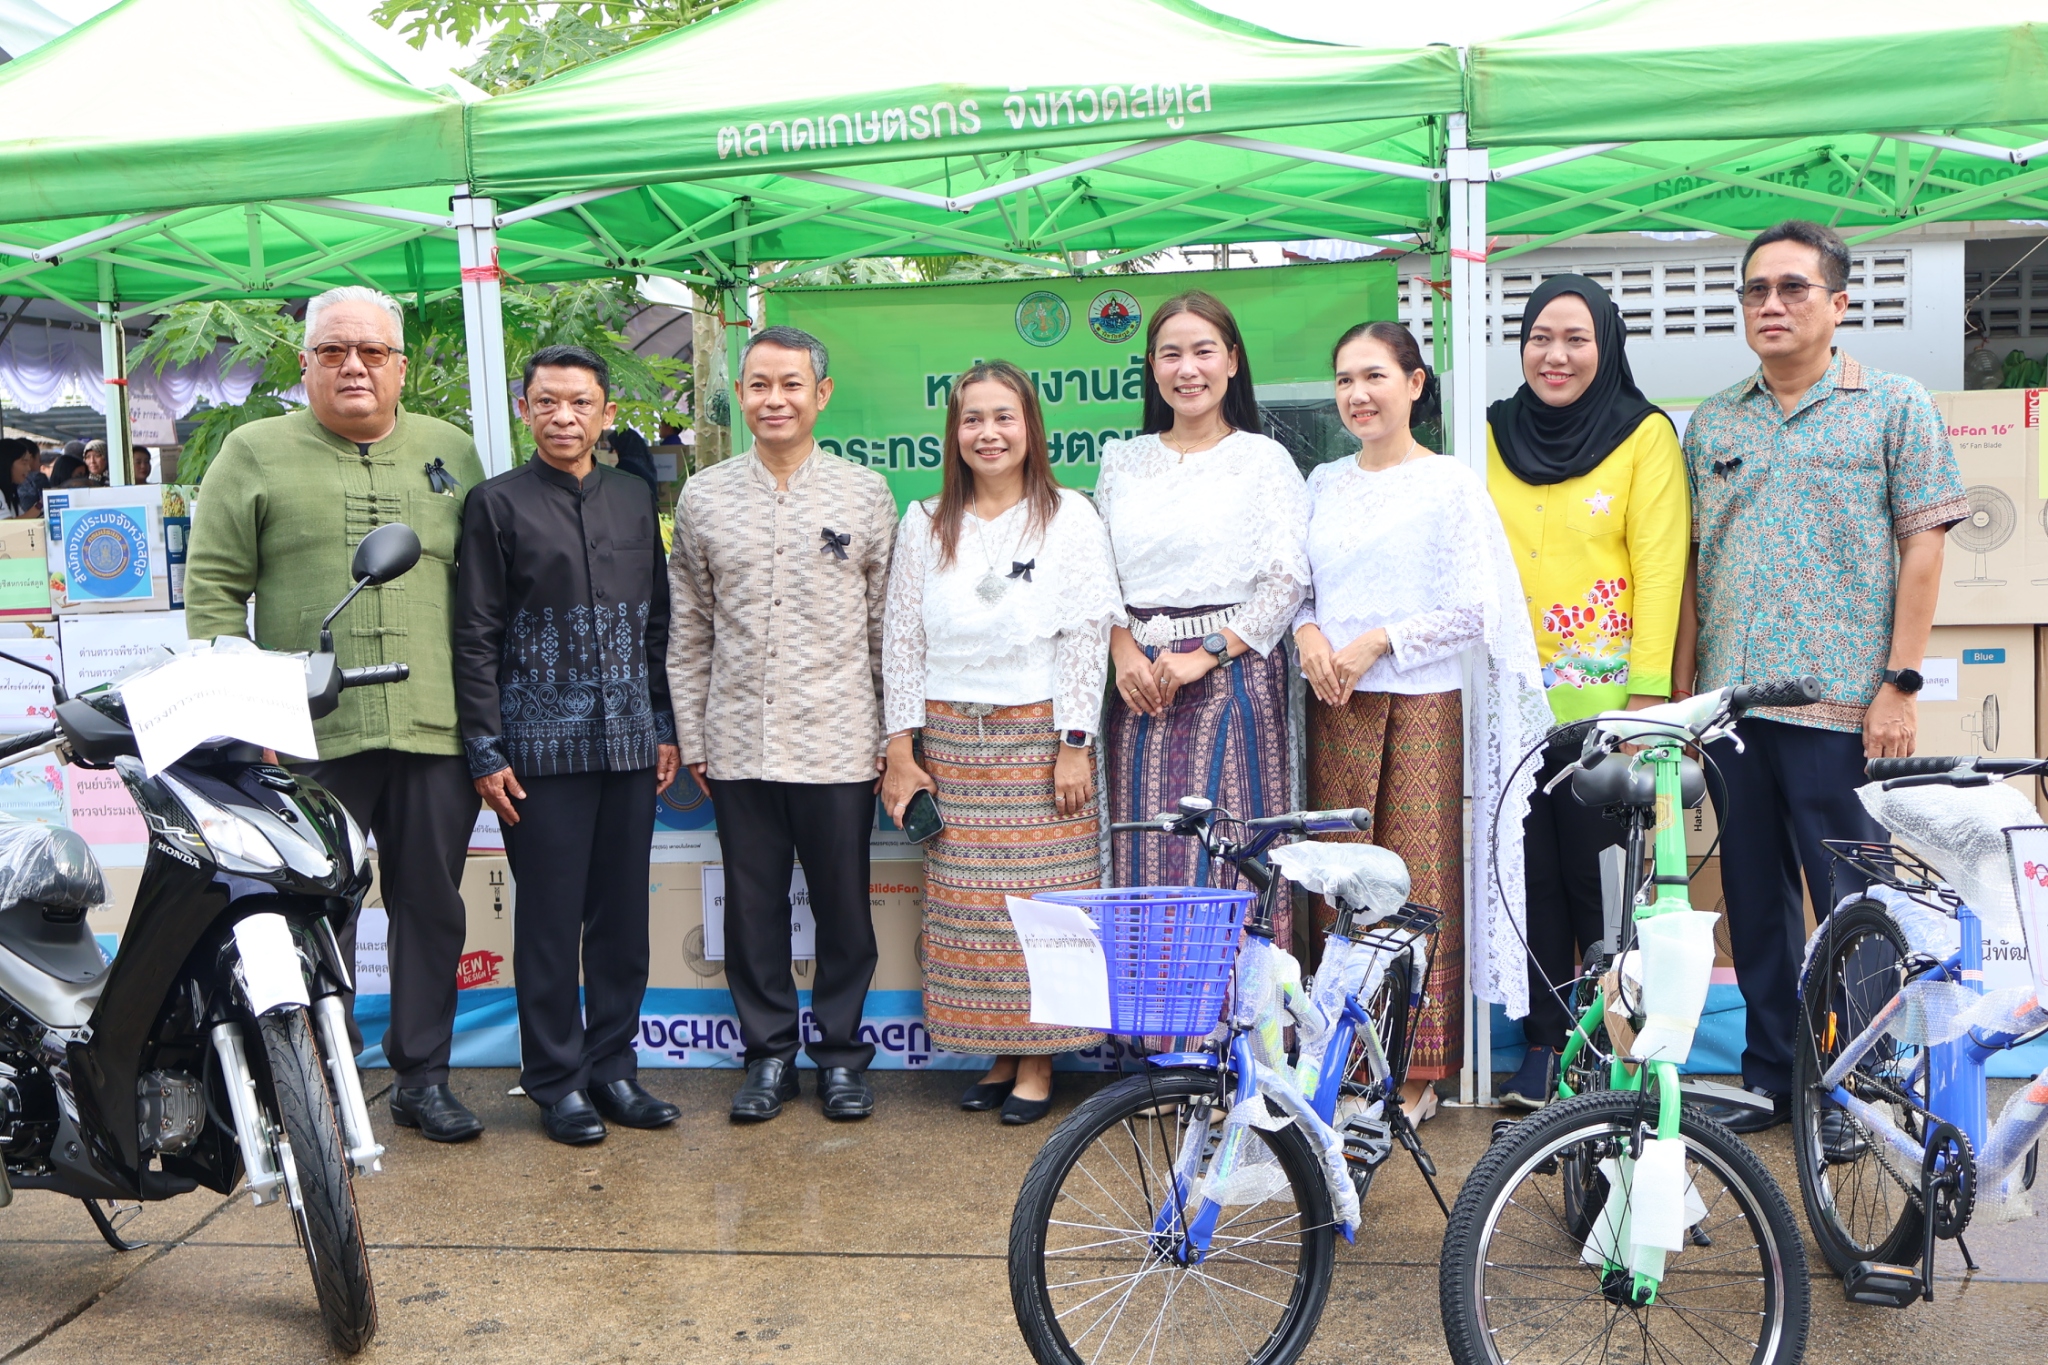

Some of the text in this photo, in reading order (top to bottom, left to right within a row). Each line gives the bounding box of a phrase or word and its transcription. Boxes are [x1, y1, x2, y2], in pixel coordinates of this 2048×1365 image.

[717, 82, 1212, 159] ตลาดเกษตรกร จังหวดสตูล
[1970, 442, 1982, 450] Fan
[1983, 441, 2002, 449] Blade
[1974, 653, 1994, 661] Blue
[157, 841, 201, 870] HONDA
[869, 883, 919, 894] SlideFan
[456, 957, 484, 978] NEW
[463, 969, 487, 984] DESIGN
